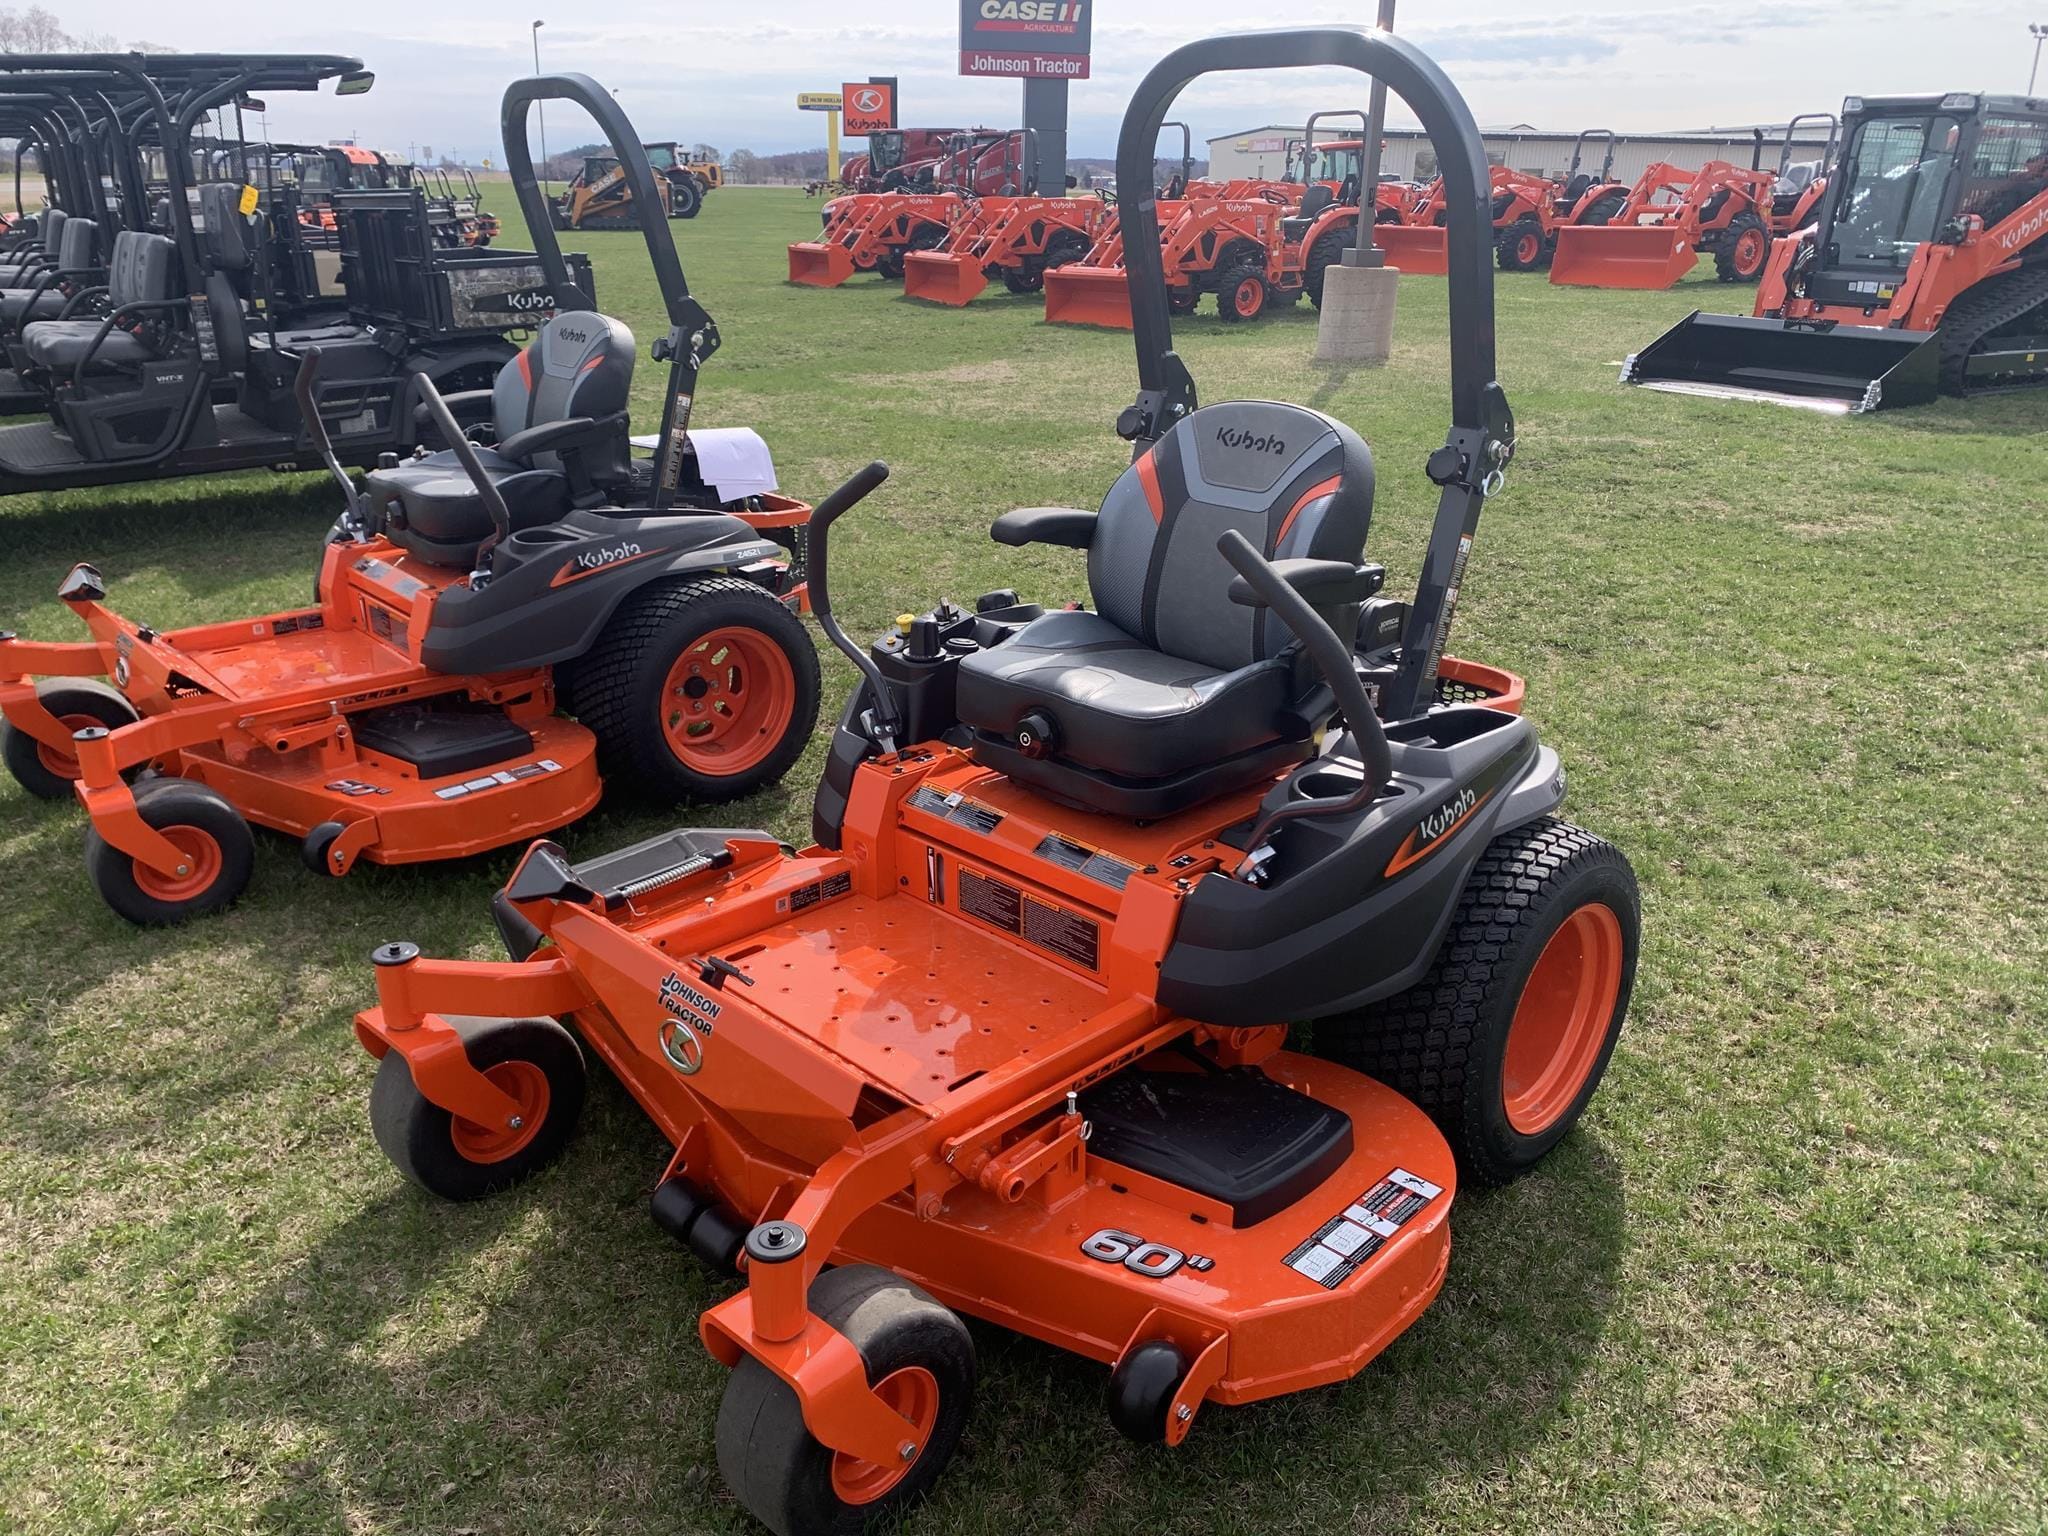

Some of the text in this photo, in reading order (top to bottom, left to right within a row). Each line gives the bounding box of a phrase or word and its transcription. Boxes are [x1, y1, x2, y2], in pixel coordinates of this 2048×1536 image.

[980, 1, 1056, 20] CASE
[1024, 23, 1073, 33] AGRICULTURE
[970, 55, 1082, 74] Johnson Tractor
[847, 118, 889, 130] Kubota
[592, 173, 617, 193] CASE
[1050, 201, 1076, 209] Kubota
[1226, 202, 1252, 212] Kubota
[507, 292, 555, 310] Kubo
[558, 327, 587, 344] Kubota
[1216, 426, 1285, 455] Kubota
[578, 541, 641, 568] Kubota
[1420, 788, 1476, 840] Kubota
[661, 971, 723, 1020] JOHNSON
[657, 987, 713, 1037] TRACTOR
[1081, 1229, 1215, 1278] 60"
